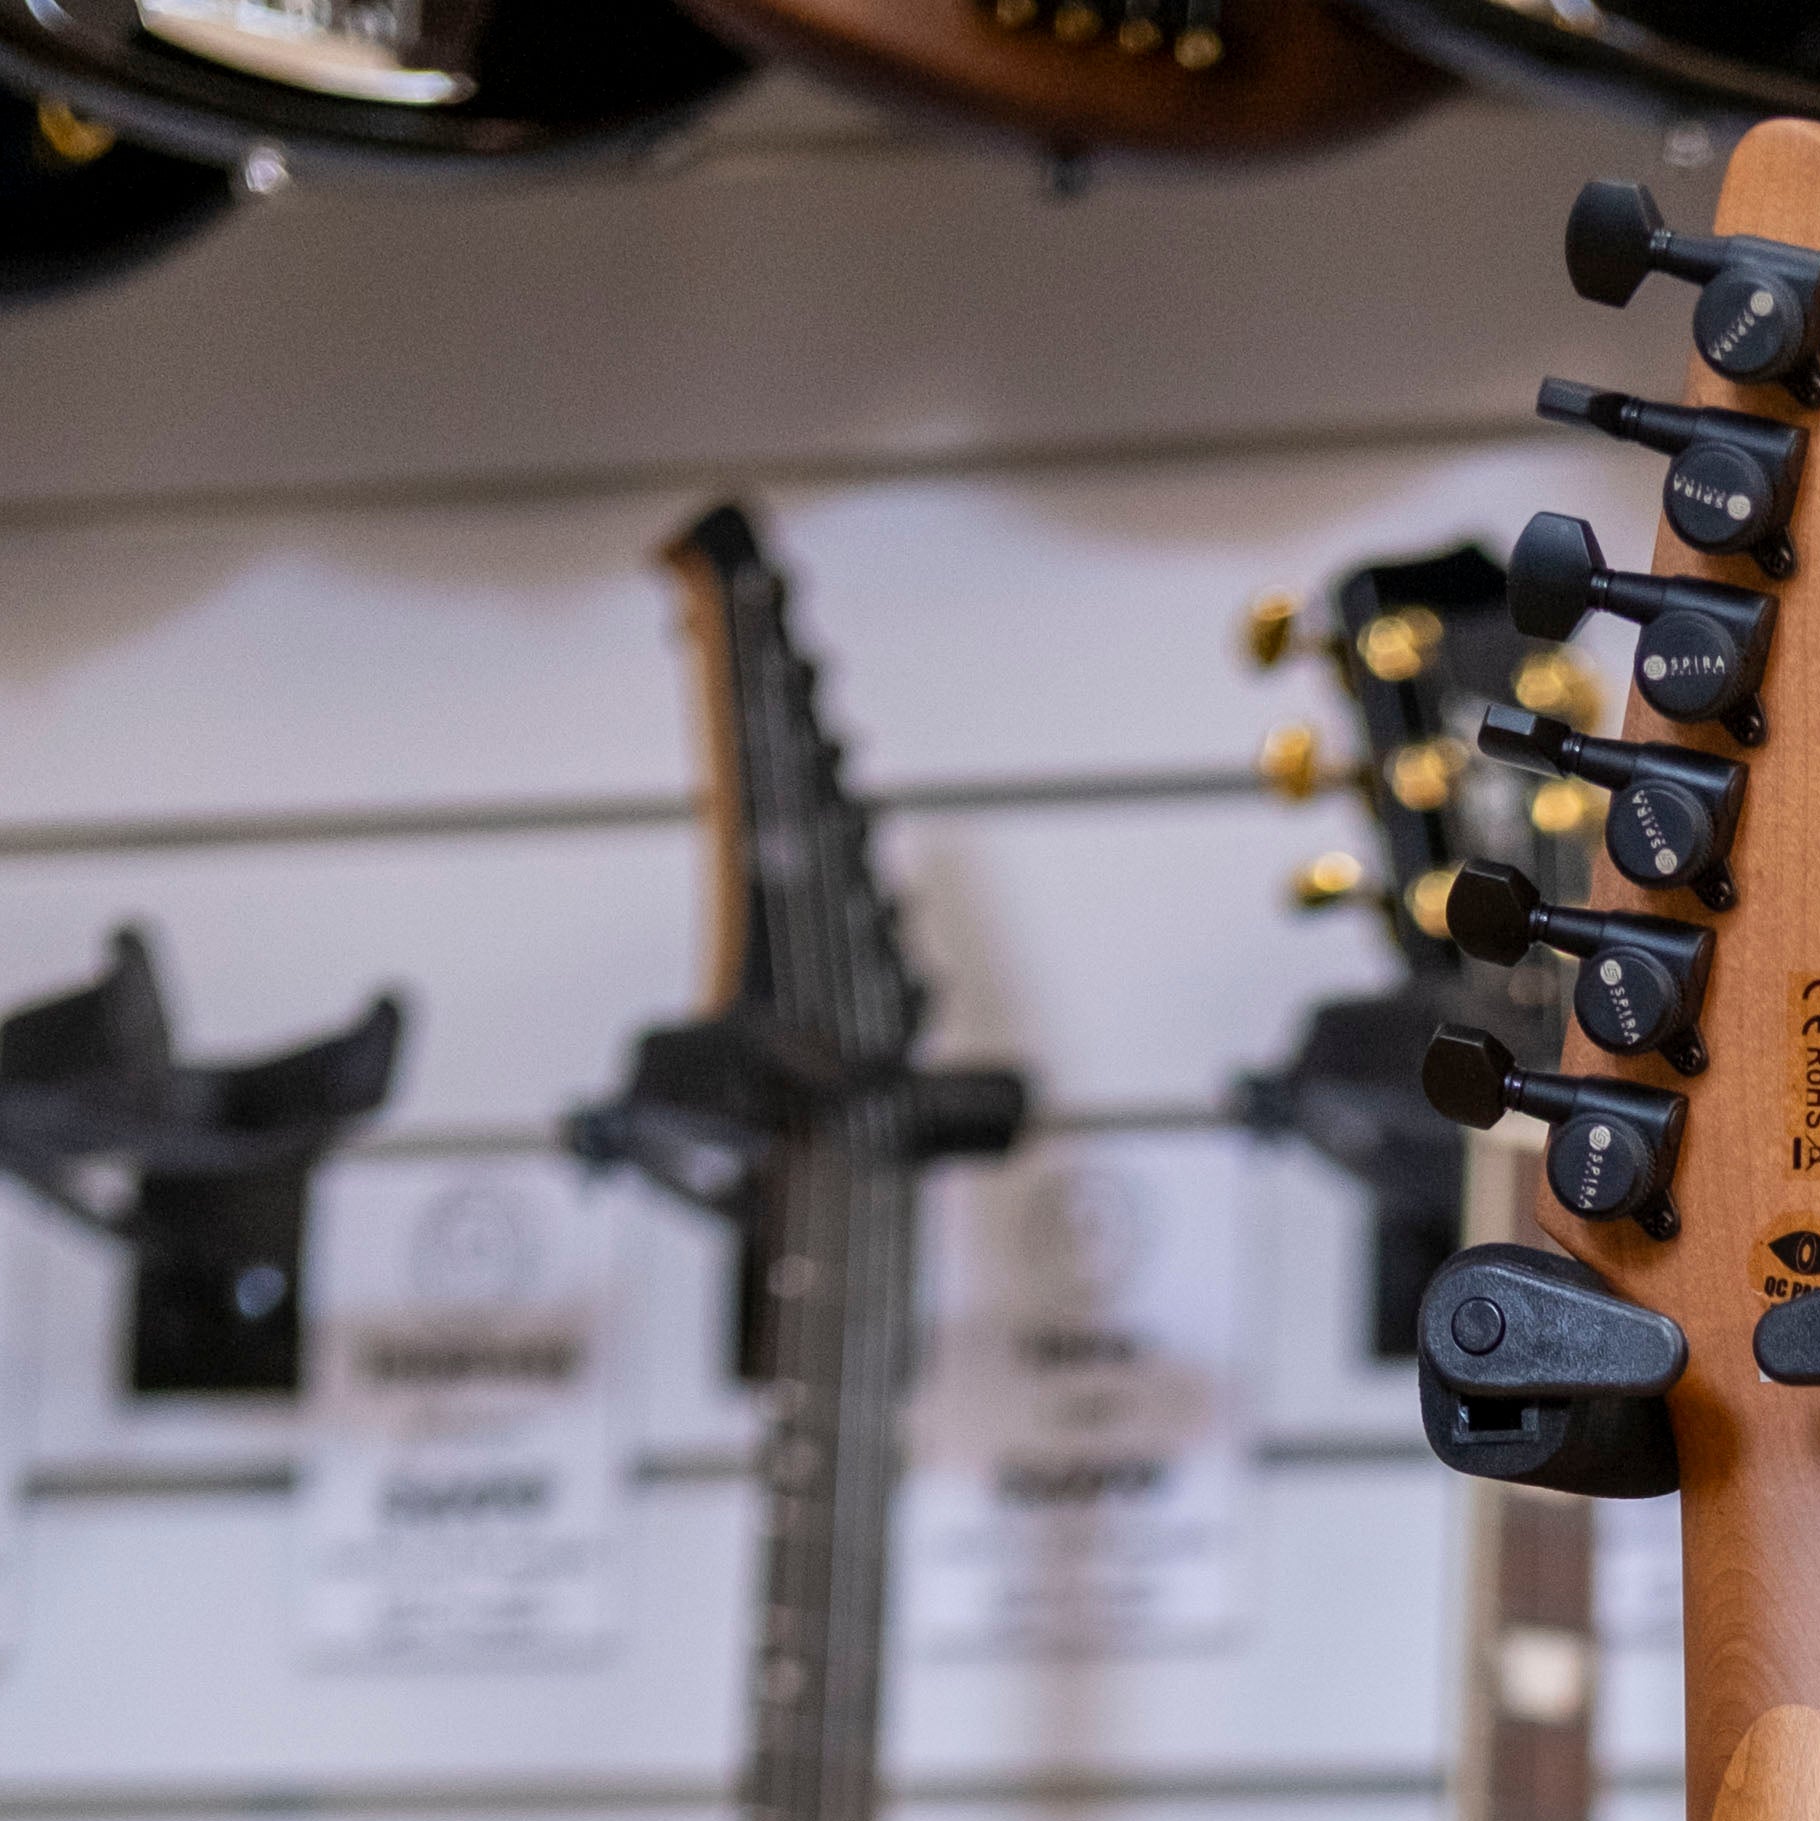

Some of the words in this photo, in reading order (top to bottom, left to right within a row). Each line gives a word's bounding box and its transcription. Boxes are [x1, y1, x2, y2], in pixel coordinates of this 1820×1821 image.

[1708, 311, 1756, 361] SPIRA
[1673, 474, 1723, 509] SPIRA
[1670, 655, 1725, 674] SPIRA
[1632, 790, 1661, 849] SPIRA
[1614, 986, 1640, 1045] SPIRA
[1579, 1154, 1603, 1209] SPIRA
[1764, 1276, 1788, 1297] QC
